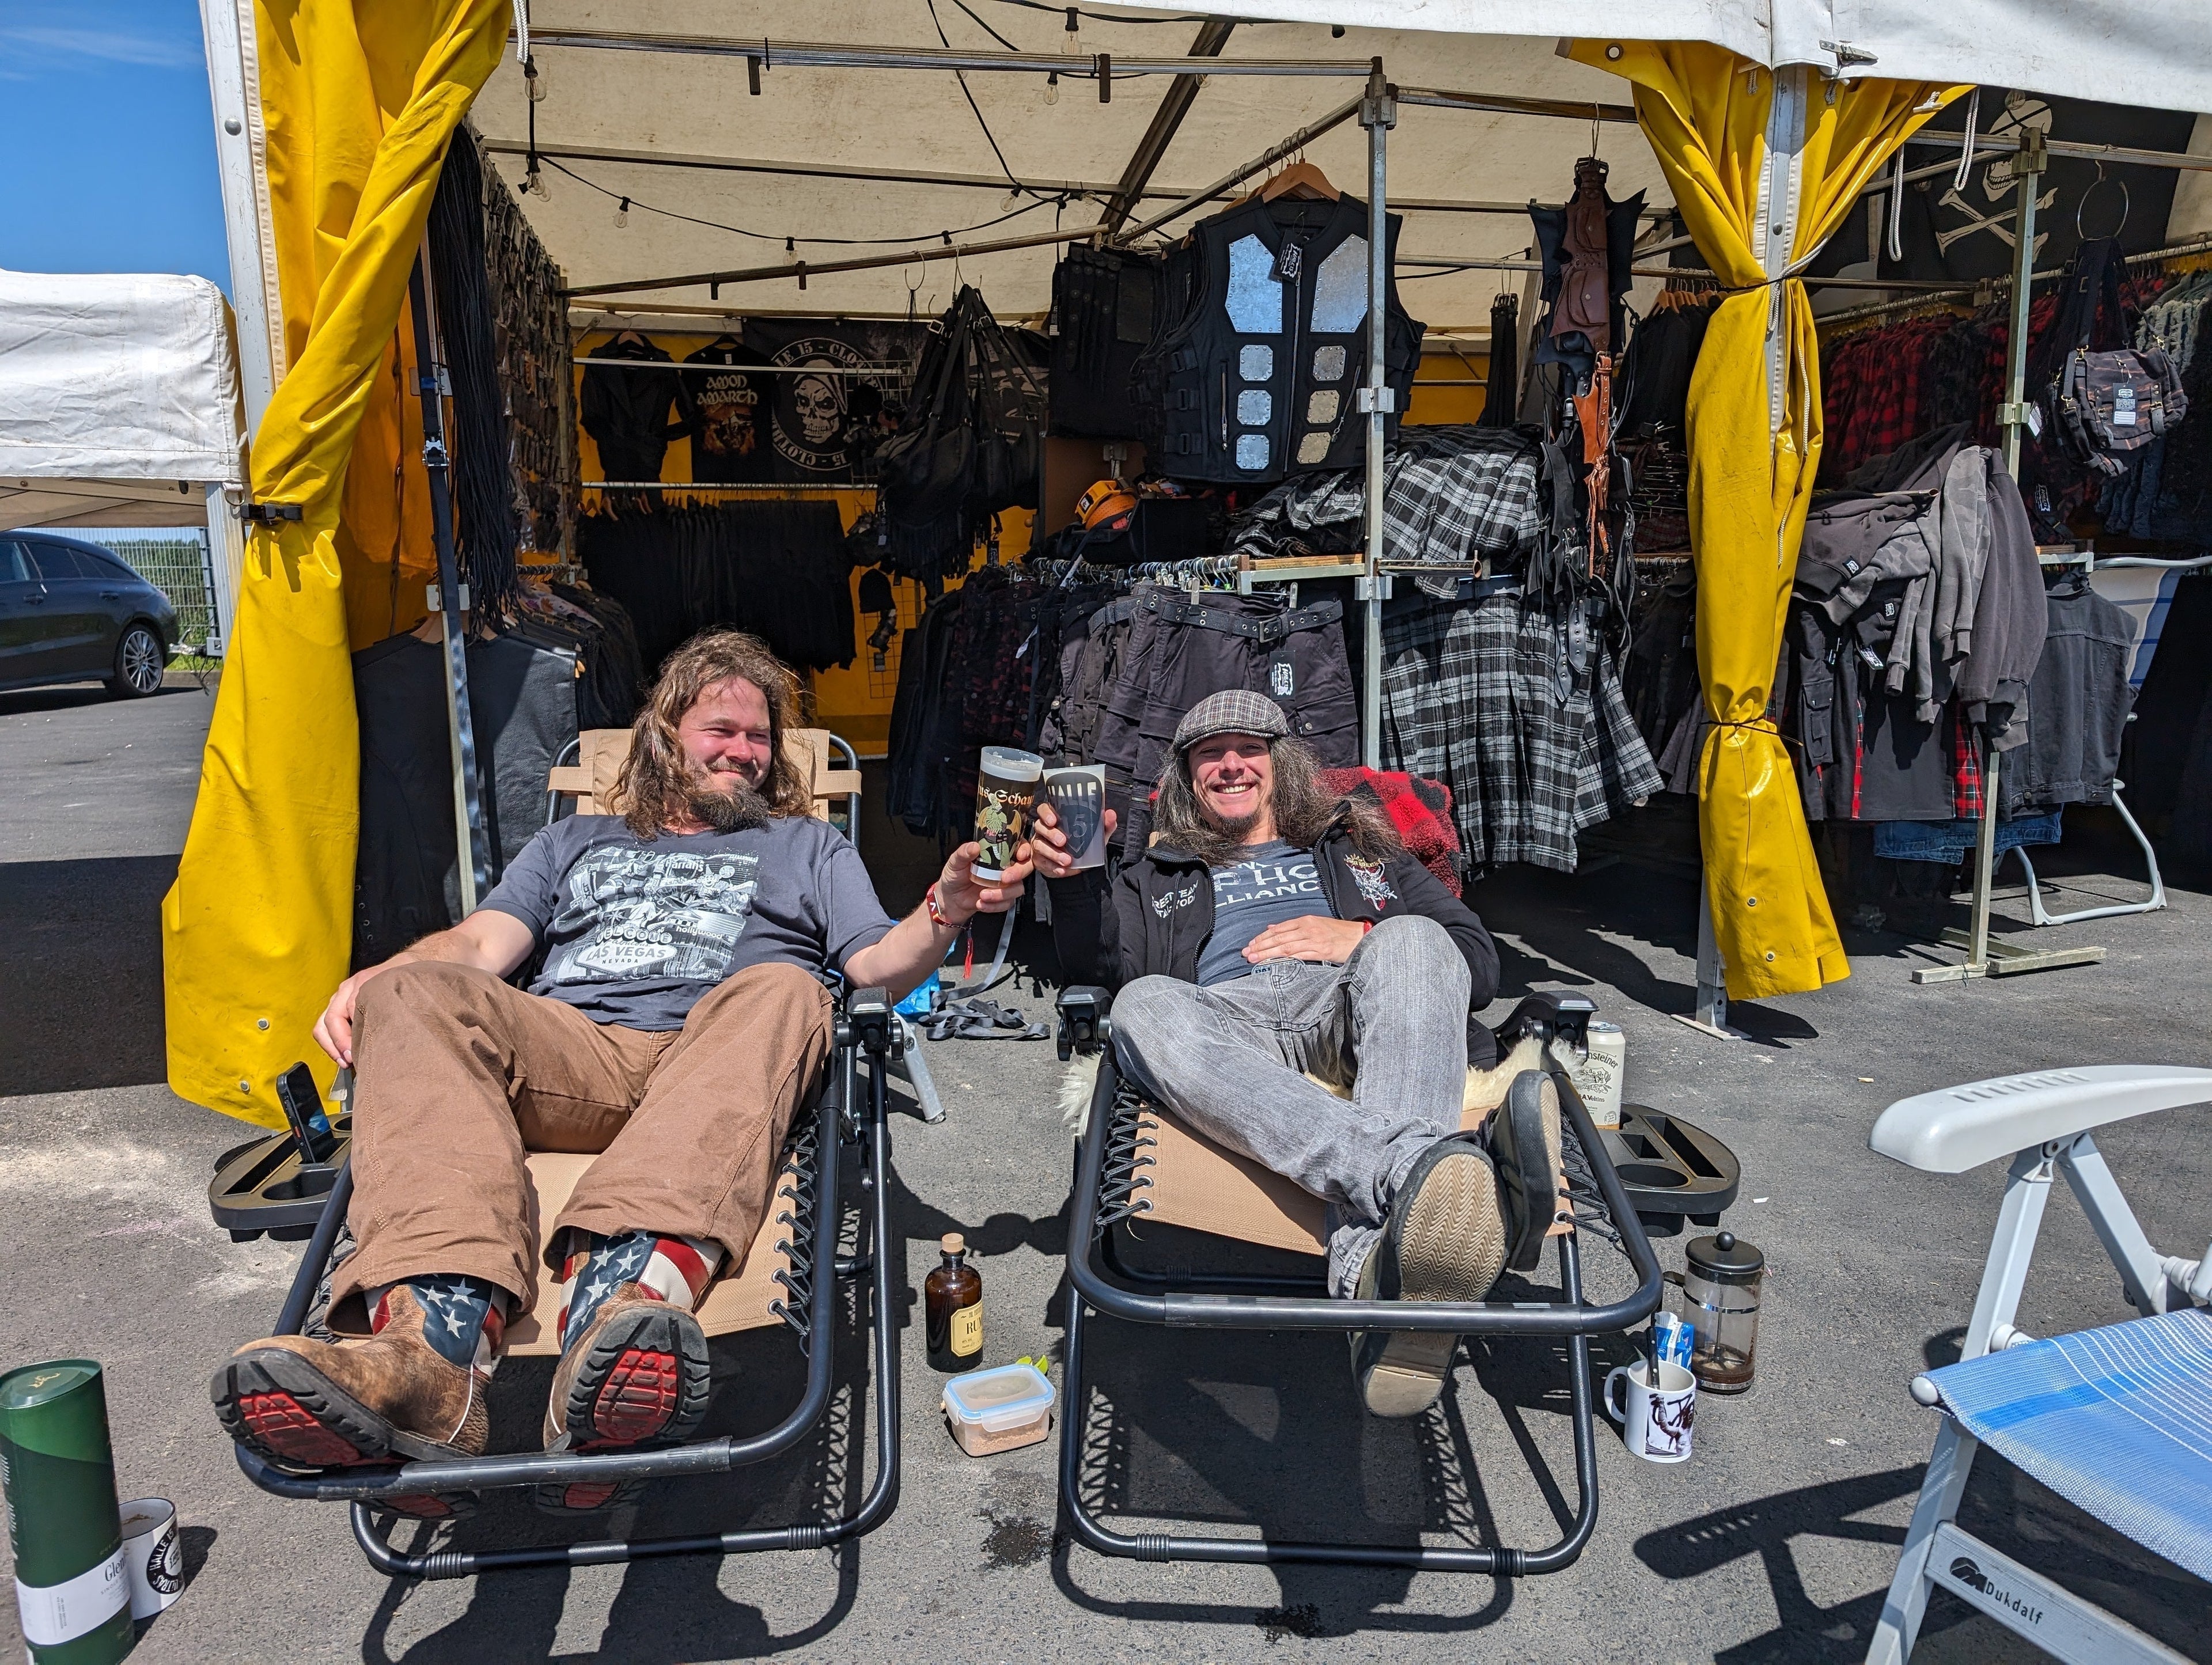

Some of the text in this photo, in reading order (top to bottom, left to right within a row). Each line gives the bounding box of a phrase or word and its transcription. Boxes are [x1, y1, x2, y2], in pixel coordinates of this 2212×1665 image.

[797, 341, 814, 356] 15
[706, 374, 748, 390] AMON
[696, 388, 759, 405] AMARTH
[1047, 782, 1097, 814] HALLE
[1215, 879, 1320, 909] LLIANC
[675, 926, 723, 940] hollywood
[586, 945, 666, 962] LAS VEGAS
[1588, 1052, 1619, 1069] nsteiner
[149, 1539, 169, 1571] HALLE
[105, 1557, 126, 1582] Glen
[1985, 1581, 2043, 1625] Dukdalf
